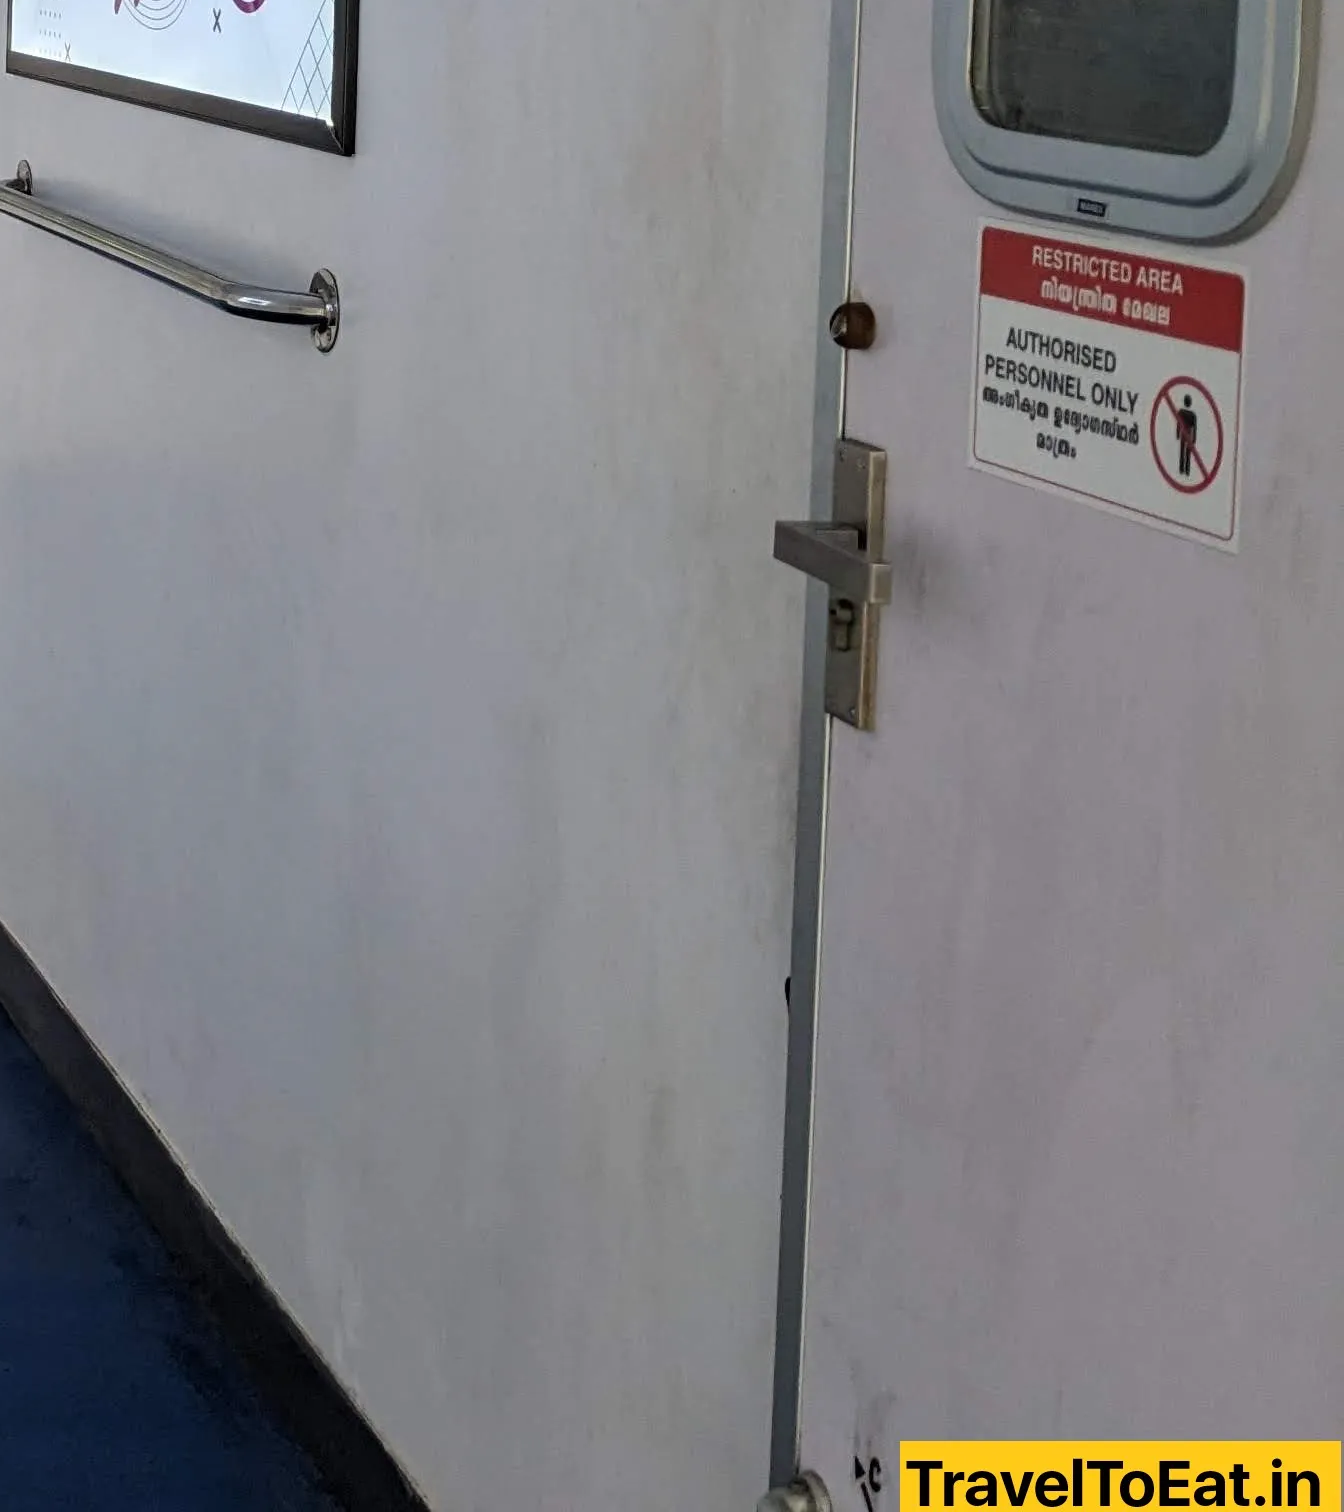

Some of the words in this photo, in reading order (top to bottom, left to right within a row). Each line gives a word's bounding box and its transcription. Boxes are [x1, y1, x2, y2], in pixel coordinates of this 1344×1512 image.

[1032, 245, 1132, 284] RESTRICTED
[1136, 266, 1184, 296] AREA
[1006, 327, 1117, 373] AUTHORISED
[985, 354, 1086, 401] PERSONNEL
[1091, 382, 1139, 416] ONLY
[868, 1457, 882, 1493] C
